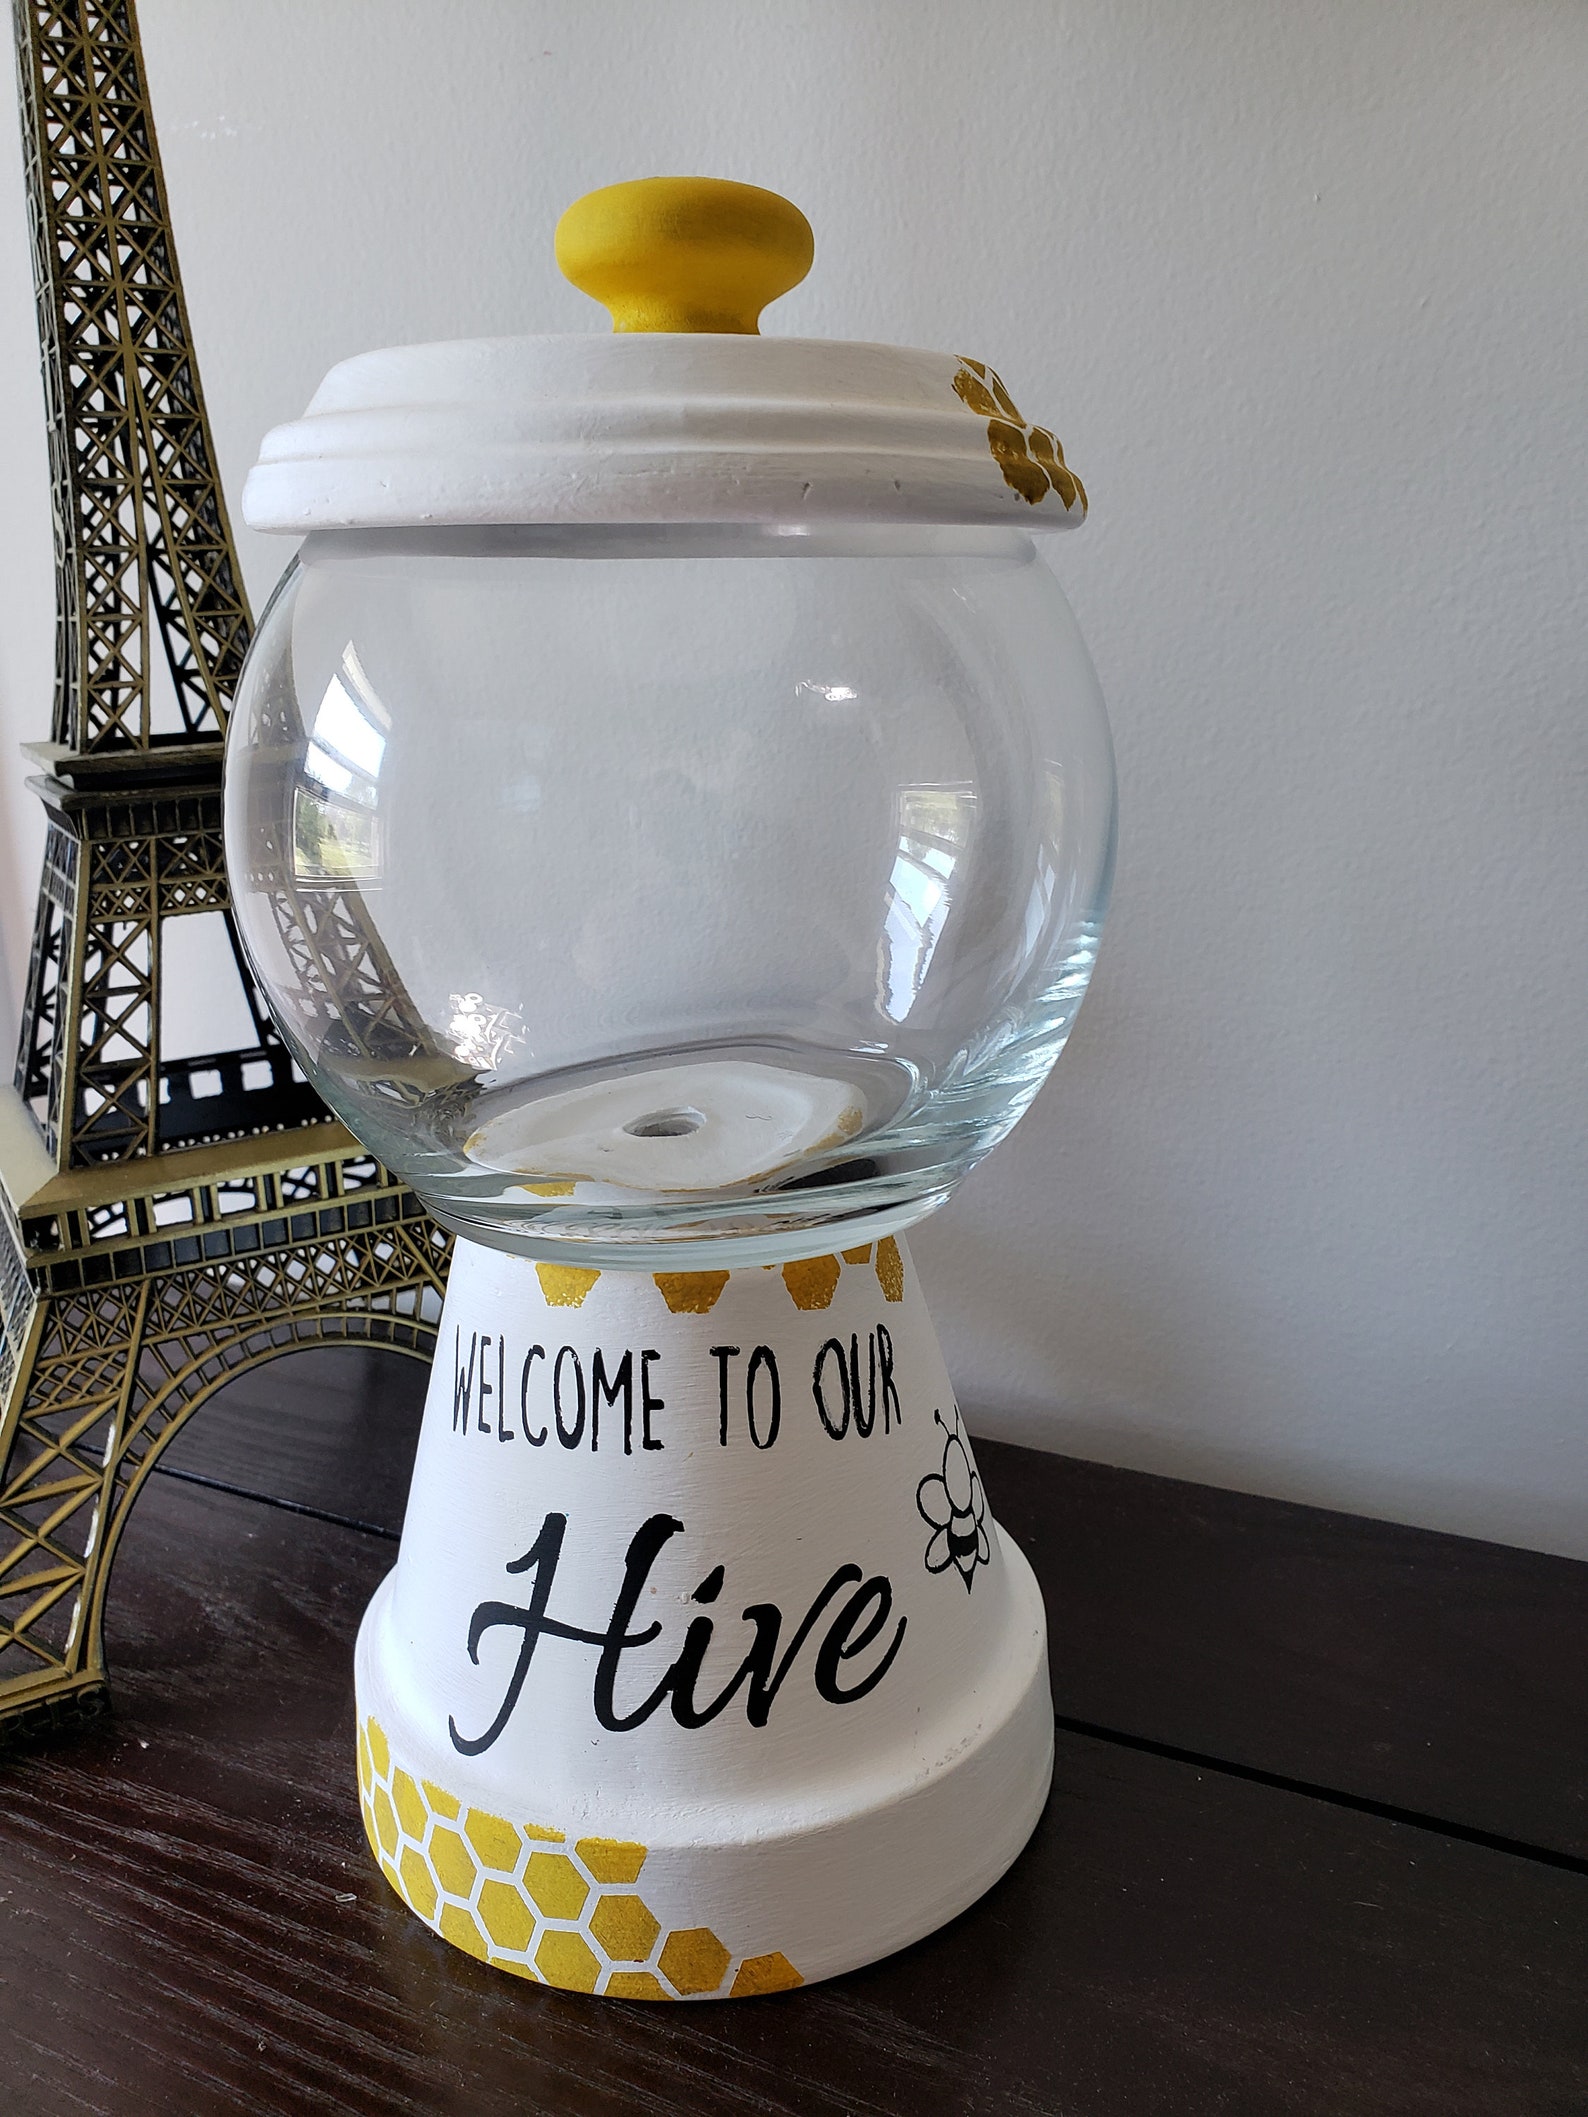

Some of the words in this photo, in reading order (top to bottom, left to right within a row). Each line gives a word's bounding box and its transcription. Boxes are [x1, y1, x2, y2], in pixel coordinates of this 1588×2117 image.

[452, 1325, 665, 1456] WELCOME
[708, 1344, 782, 1450] TO
[811, 1323, 902, 1442] OUR
[448, 1512, 908, 1757] Hive
